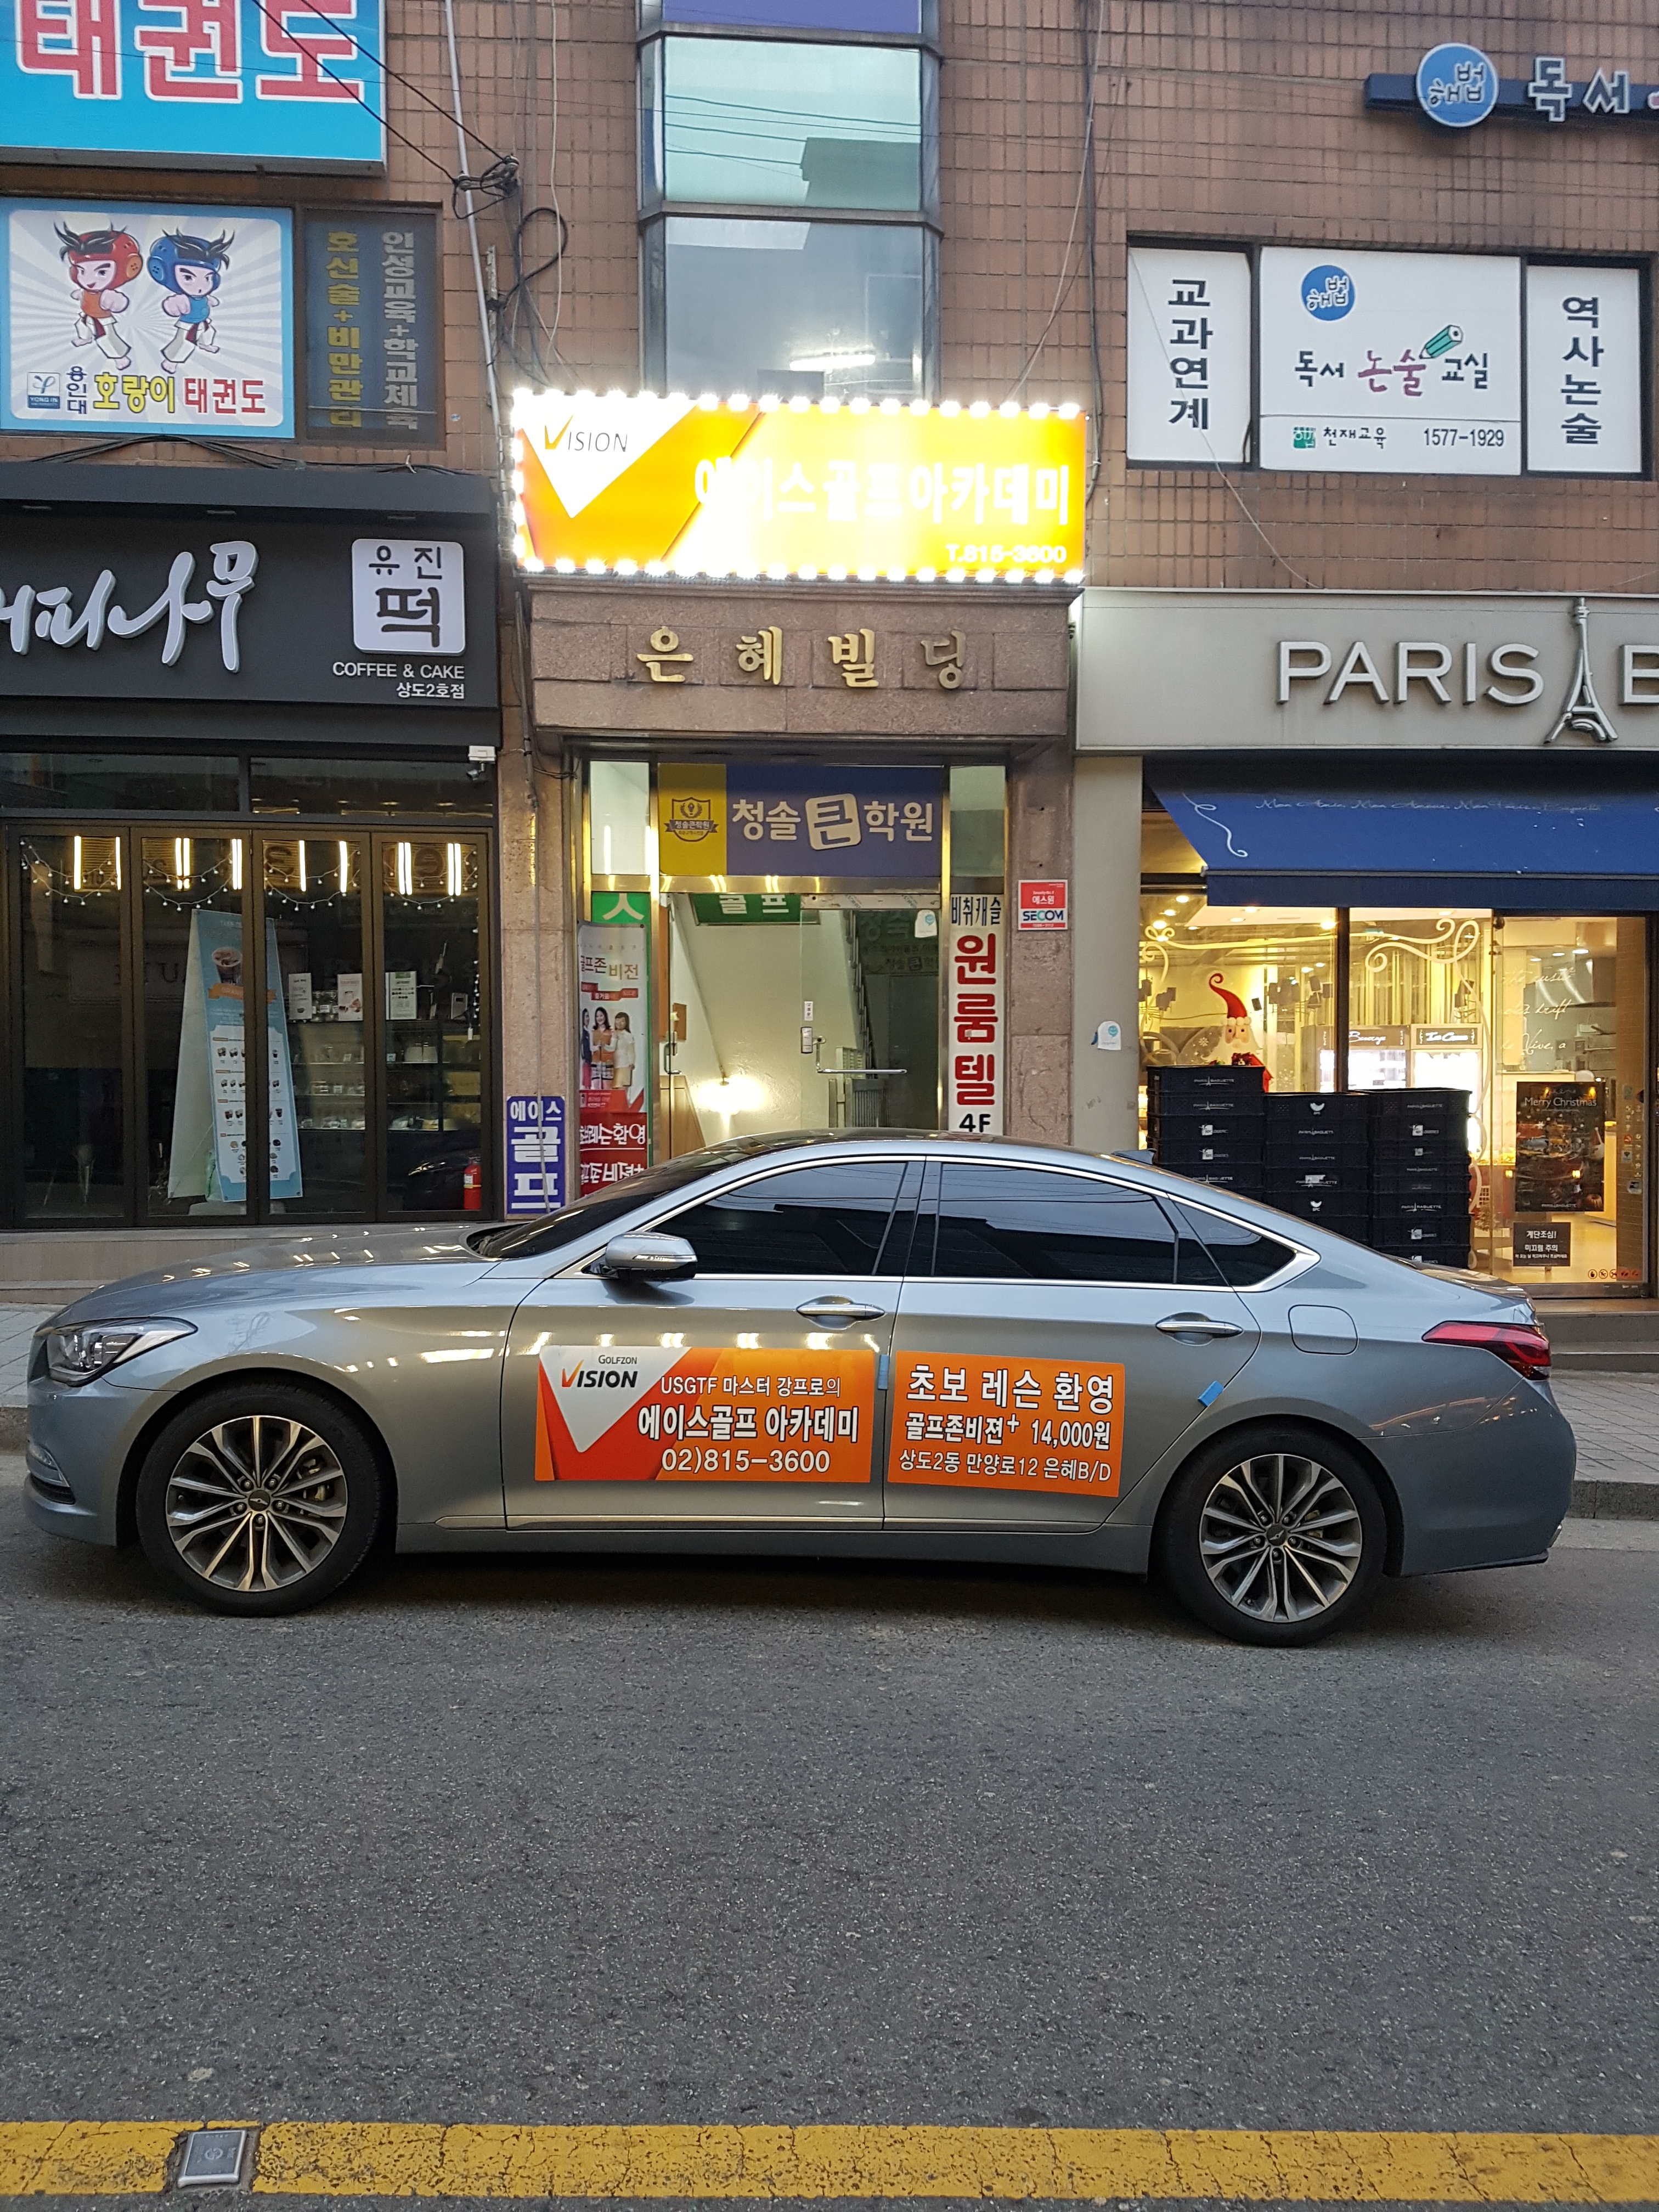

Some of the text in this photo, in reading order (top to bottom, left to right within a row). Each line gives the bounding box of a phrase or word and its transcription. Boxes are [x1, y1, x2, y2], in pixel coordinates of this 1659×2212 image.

[15, 0, 364, 104] 태권도
[1527, 57, 1629, 123] 독서
[1167, 278, 1214, 431] 교과연계
[1560, 296, 1604, 445] 역사논술
[66, 366, 87, 414] 용인대
[1294, 349, 1489, 397] 독서 논술 교실
[93, 371, 266, 416] 호랑이 태권도
[544, 414, 628, 453] VISION
[1323, 426, 1387, 449] 천재교육
[1423, 427, 1505, 448] 1577-1929
[368, 545, 443, 580] 유진
[375, 586, 441, 648] 떡
[332, 661, 465, 680] COFFEE & CAKE
[636, 625, 968, 689] 은혜빌딩
[1277, 641, 1544, 706] PARIS
[396, 681, 465, 699] 상도2호점
[732, 793, 933, 850] 청솔큰학원
[951, 896, 1002, 927] 비취캐슬
[1023, 910, 1064, 921] SECOM
[954, 933, 998, 1106] 원룸텔
[510, 1101, 562, 1121] 에이스
[1525, 1097, 1597, 1108] Merry Christmas
[959, 1113, 991, 1132] 4F
[511, 1127, 562, 1209] 골프
[1526, 1231, 1556, 1239] 계단조심!
[561, 1359, 638, 1388] VISION
[598, 1354, 637, 1365] GOLFZON
[661, 1375, 840, 1397] USGTF 마스터 강프로의
[906, 1364, 1114, 1415] 초보 레슨 환영
[637, 1404, 859, 1443] 에이스골프 아카데미
[1031, 1419, 1110, 1451] 14,000원
[661, 1448, 831, 1474] 02)815-3600
[899, 1449, 1112, 1482] 상도2동 만양로12 은혜B/D
